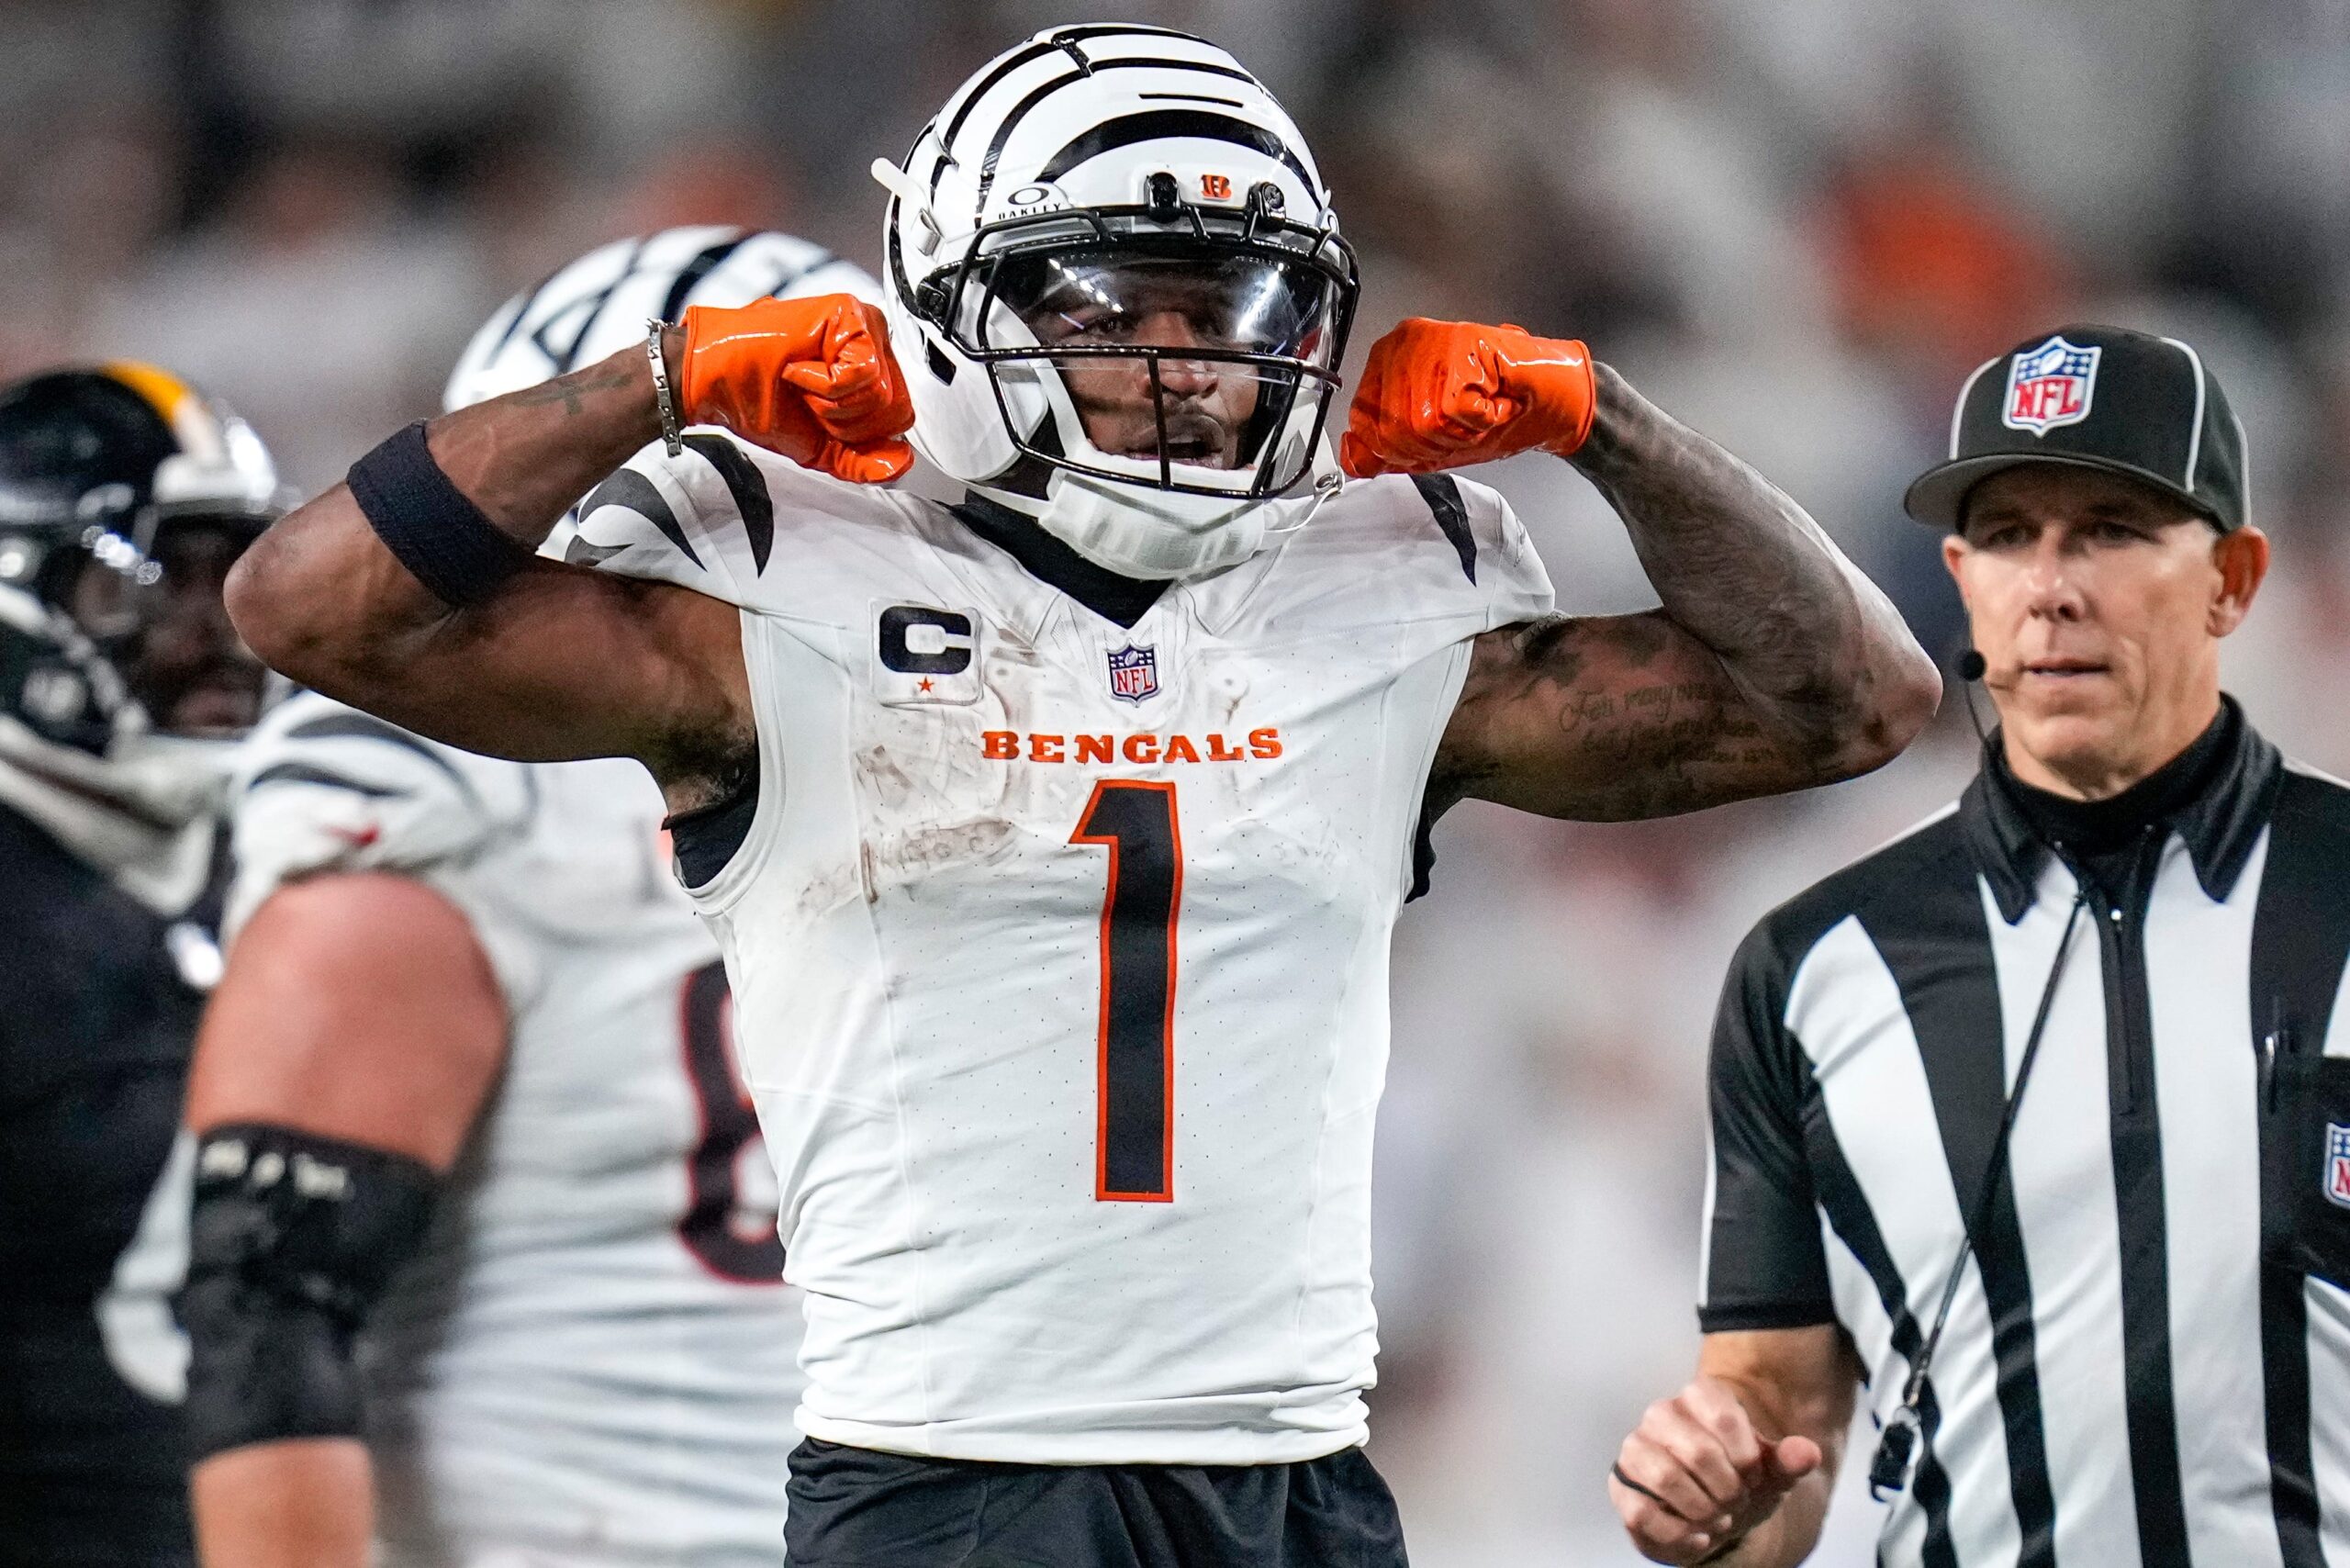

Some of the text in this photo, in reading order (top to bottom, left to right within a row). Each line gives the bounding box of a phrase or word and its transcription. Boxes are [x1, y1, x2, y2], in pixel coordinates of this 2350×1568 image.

[2011, 377, 2082, 420] NFL
[879, 606, 971, 675] C
[1115, 668, 1153, 694] NFL
[980, 728, 1283, 764] BENGALS
[1069, 779, 1182, 1203] 1
